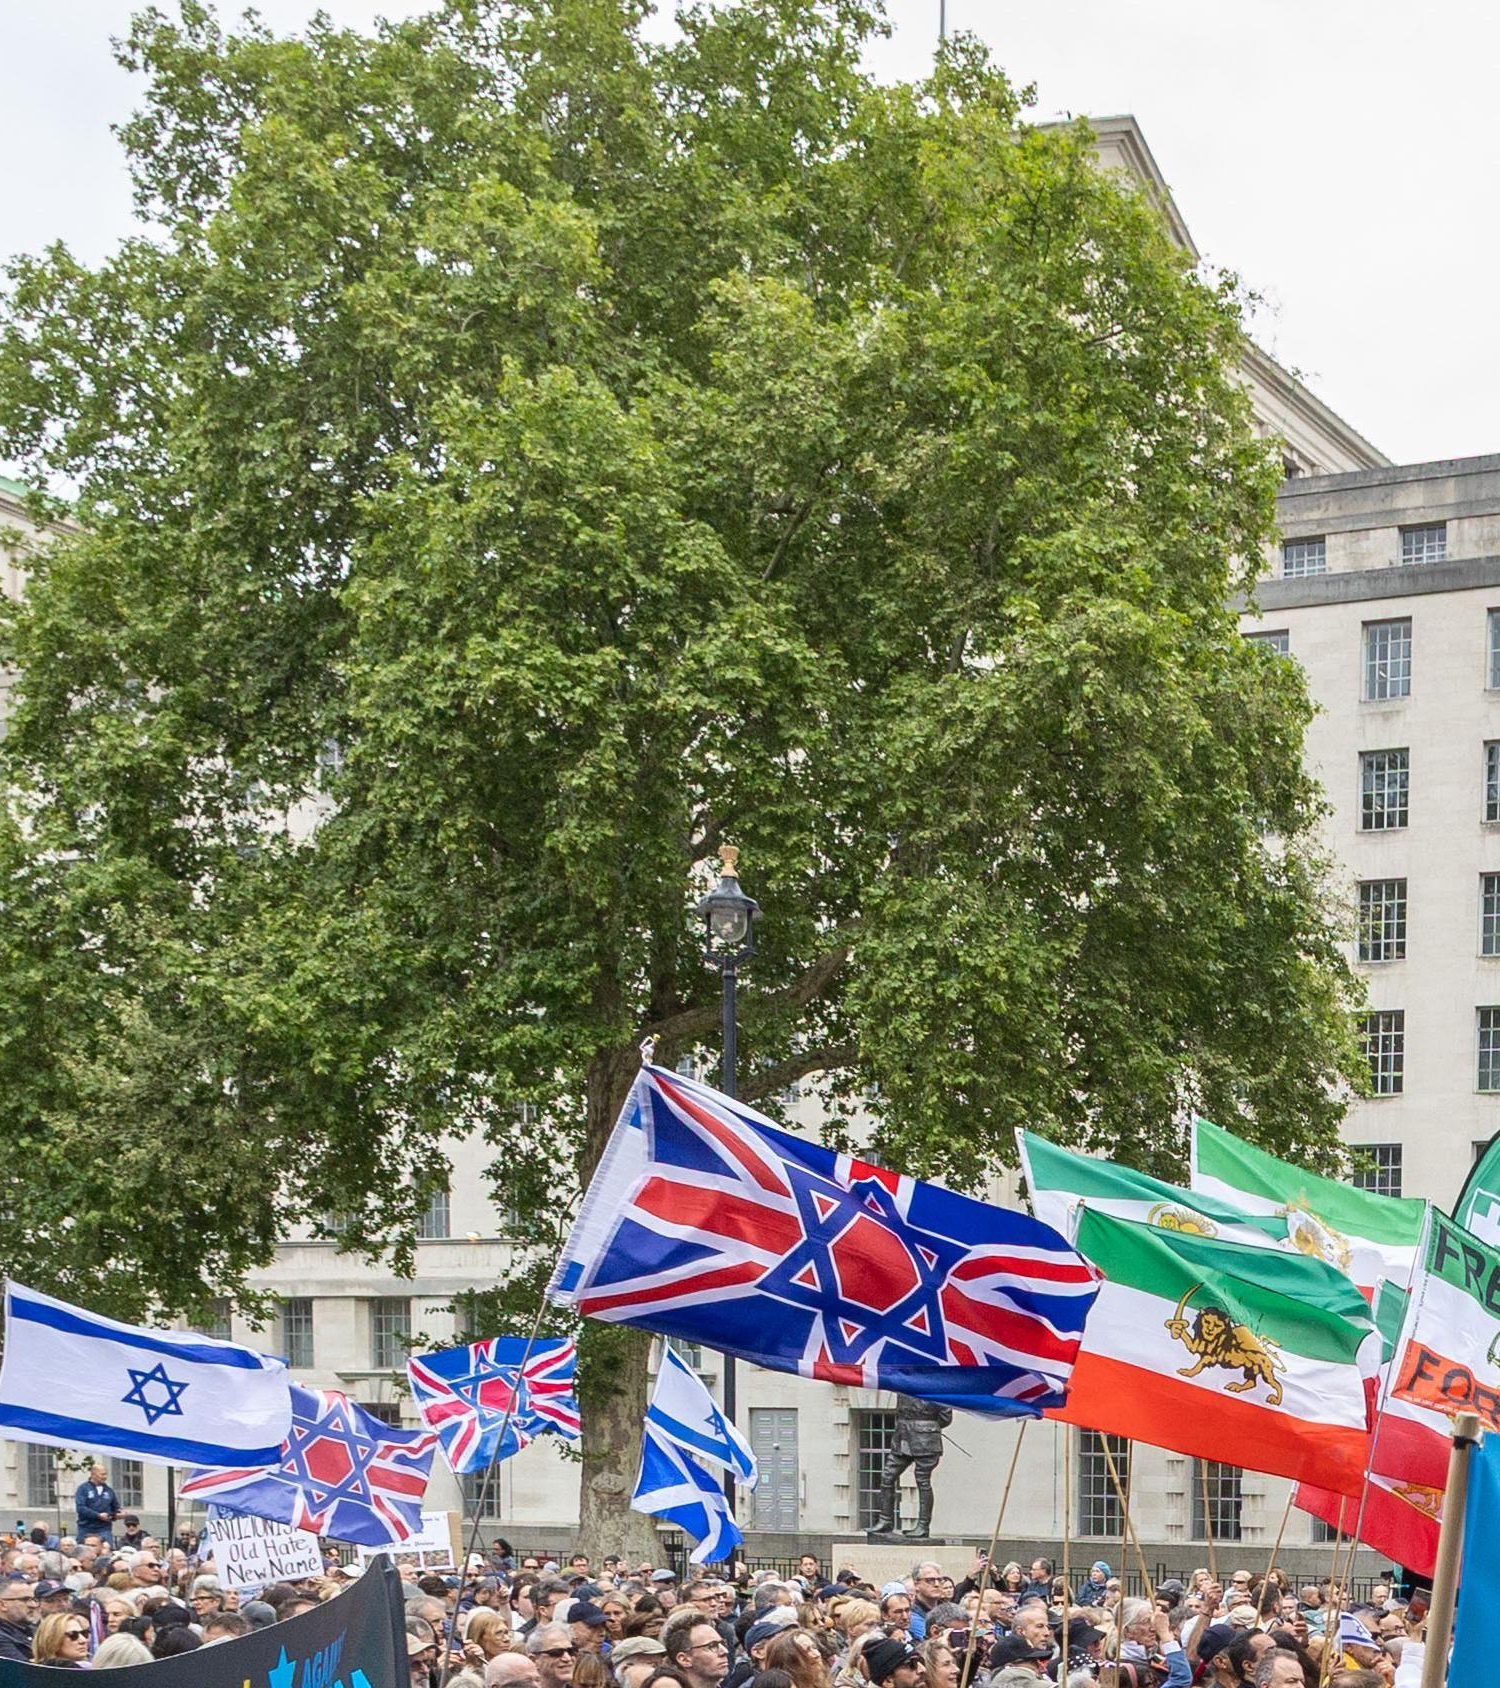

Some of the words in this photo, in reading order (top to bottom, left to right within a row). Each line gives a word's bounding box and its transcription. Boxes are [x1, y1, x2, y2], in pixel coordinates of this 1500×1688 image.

[209, 1516, 298, 1542] ANTIZIONIS
[229, 1543, 260, 1563] Old
[264, 1536, 312, 1558] Hate,
[226, 1564, 266, 1585] New
[269, 1557, 319, 1578] Name
